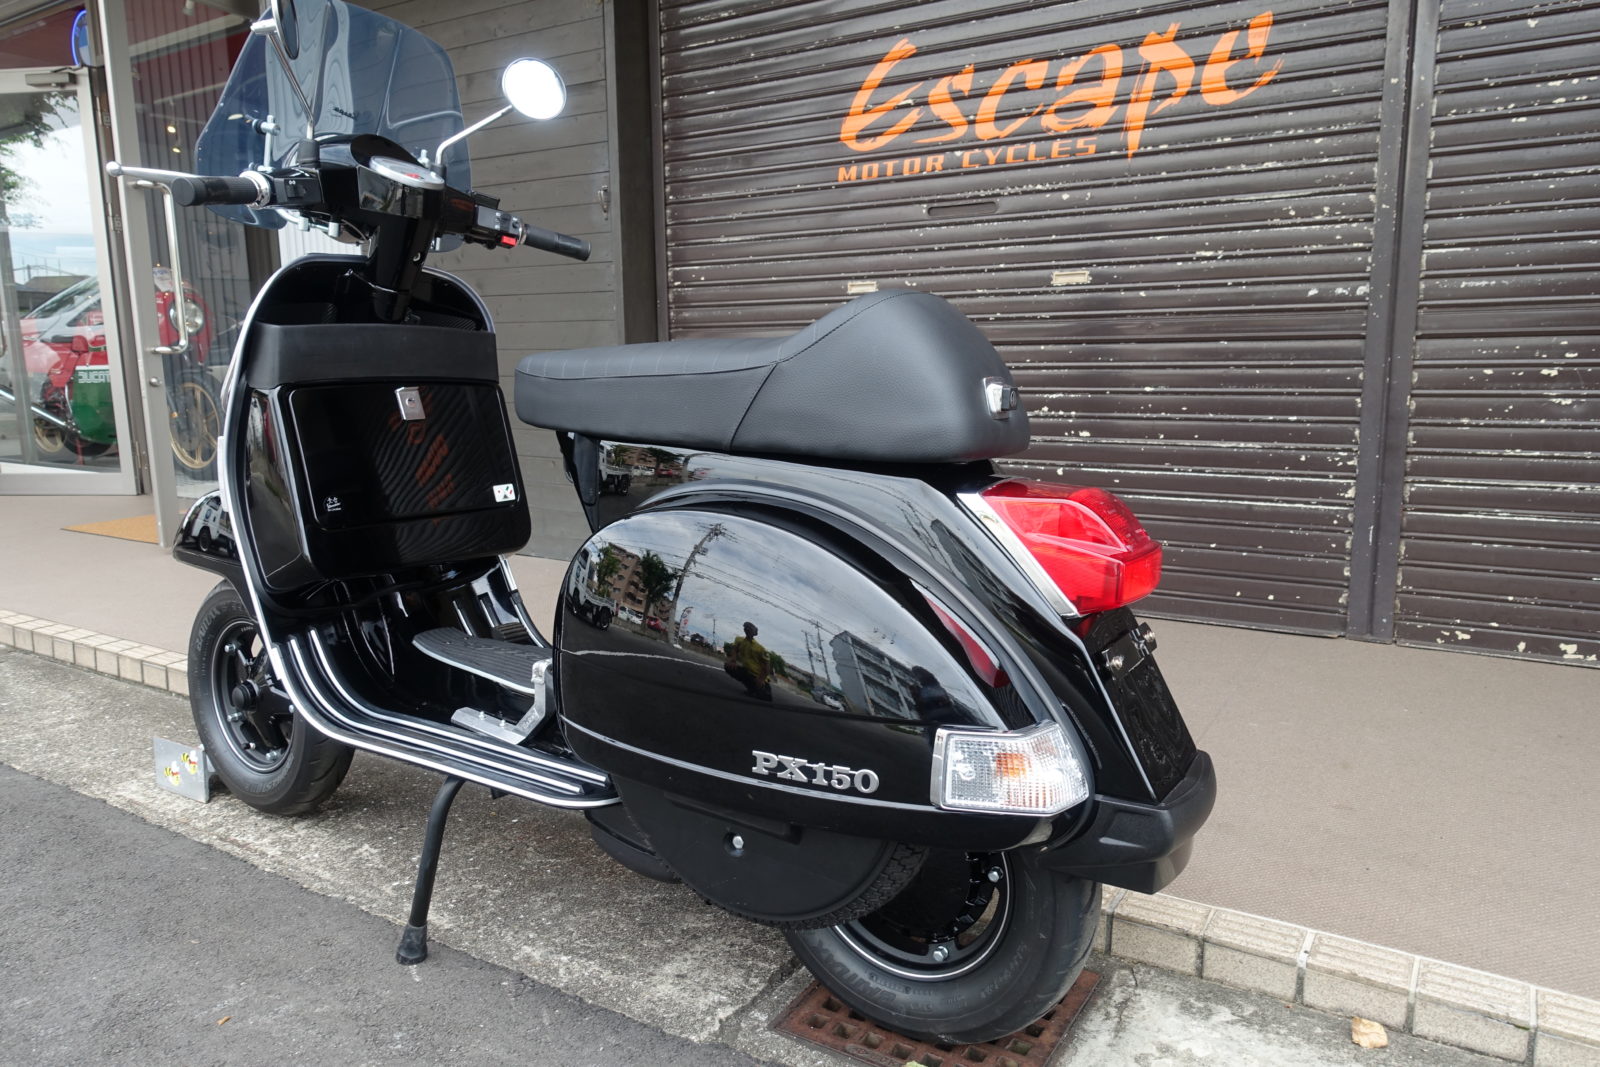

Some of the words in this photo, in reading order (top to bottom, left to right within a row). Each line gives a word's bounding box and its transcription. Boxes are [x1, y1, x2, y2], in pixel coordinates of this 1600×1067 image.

[839, 11, 1283, 161] Escape
[837, 155, 944, 182] MOTOR
[962, 138, 1098, 168] CYCLES
[78, 370, 111, 383] DUCAT
[752, 750, 880, 793] PX150
